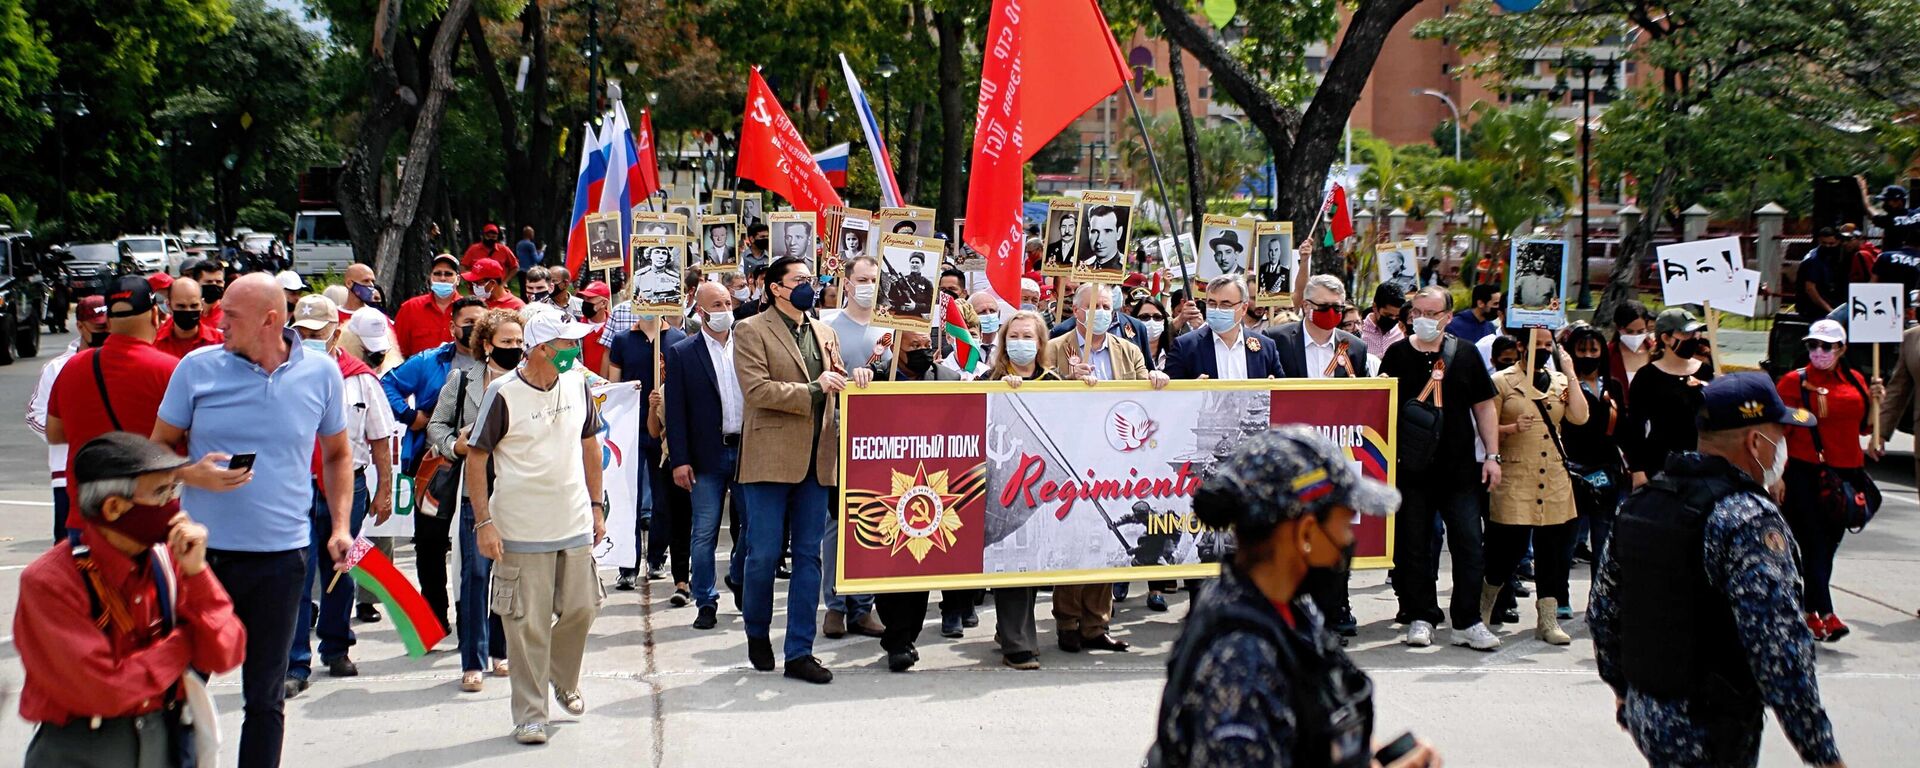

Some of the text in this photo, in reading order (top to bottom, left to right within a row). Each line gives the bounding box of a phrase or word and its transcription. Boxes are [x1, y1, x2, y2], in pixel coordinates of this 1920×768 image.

[851, 434, 980, 460] БЕССМЕРТНЫЙ ПОЛК
[1000, 451, 1204, 522] Regimiento
